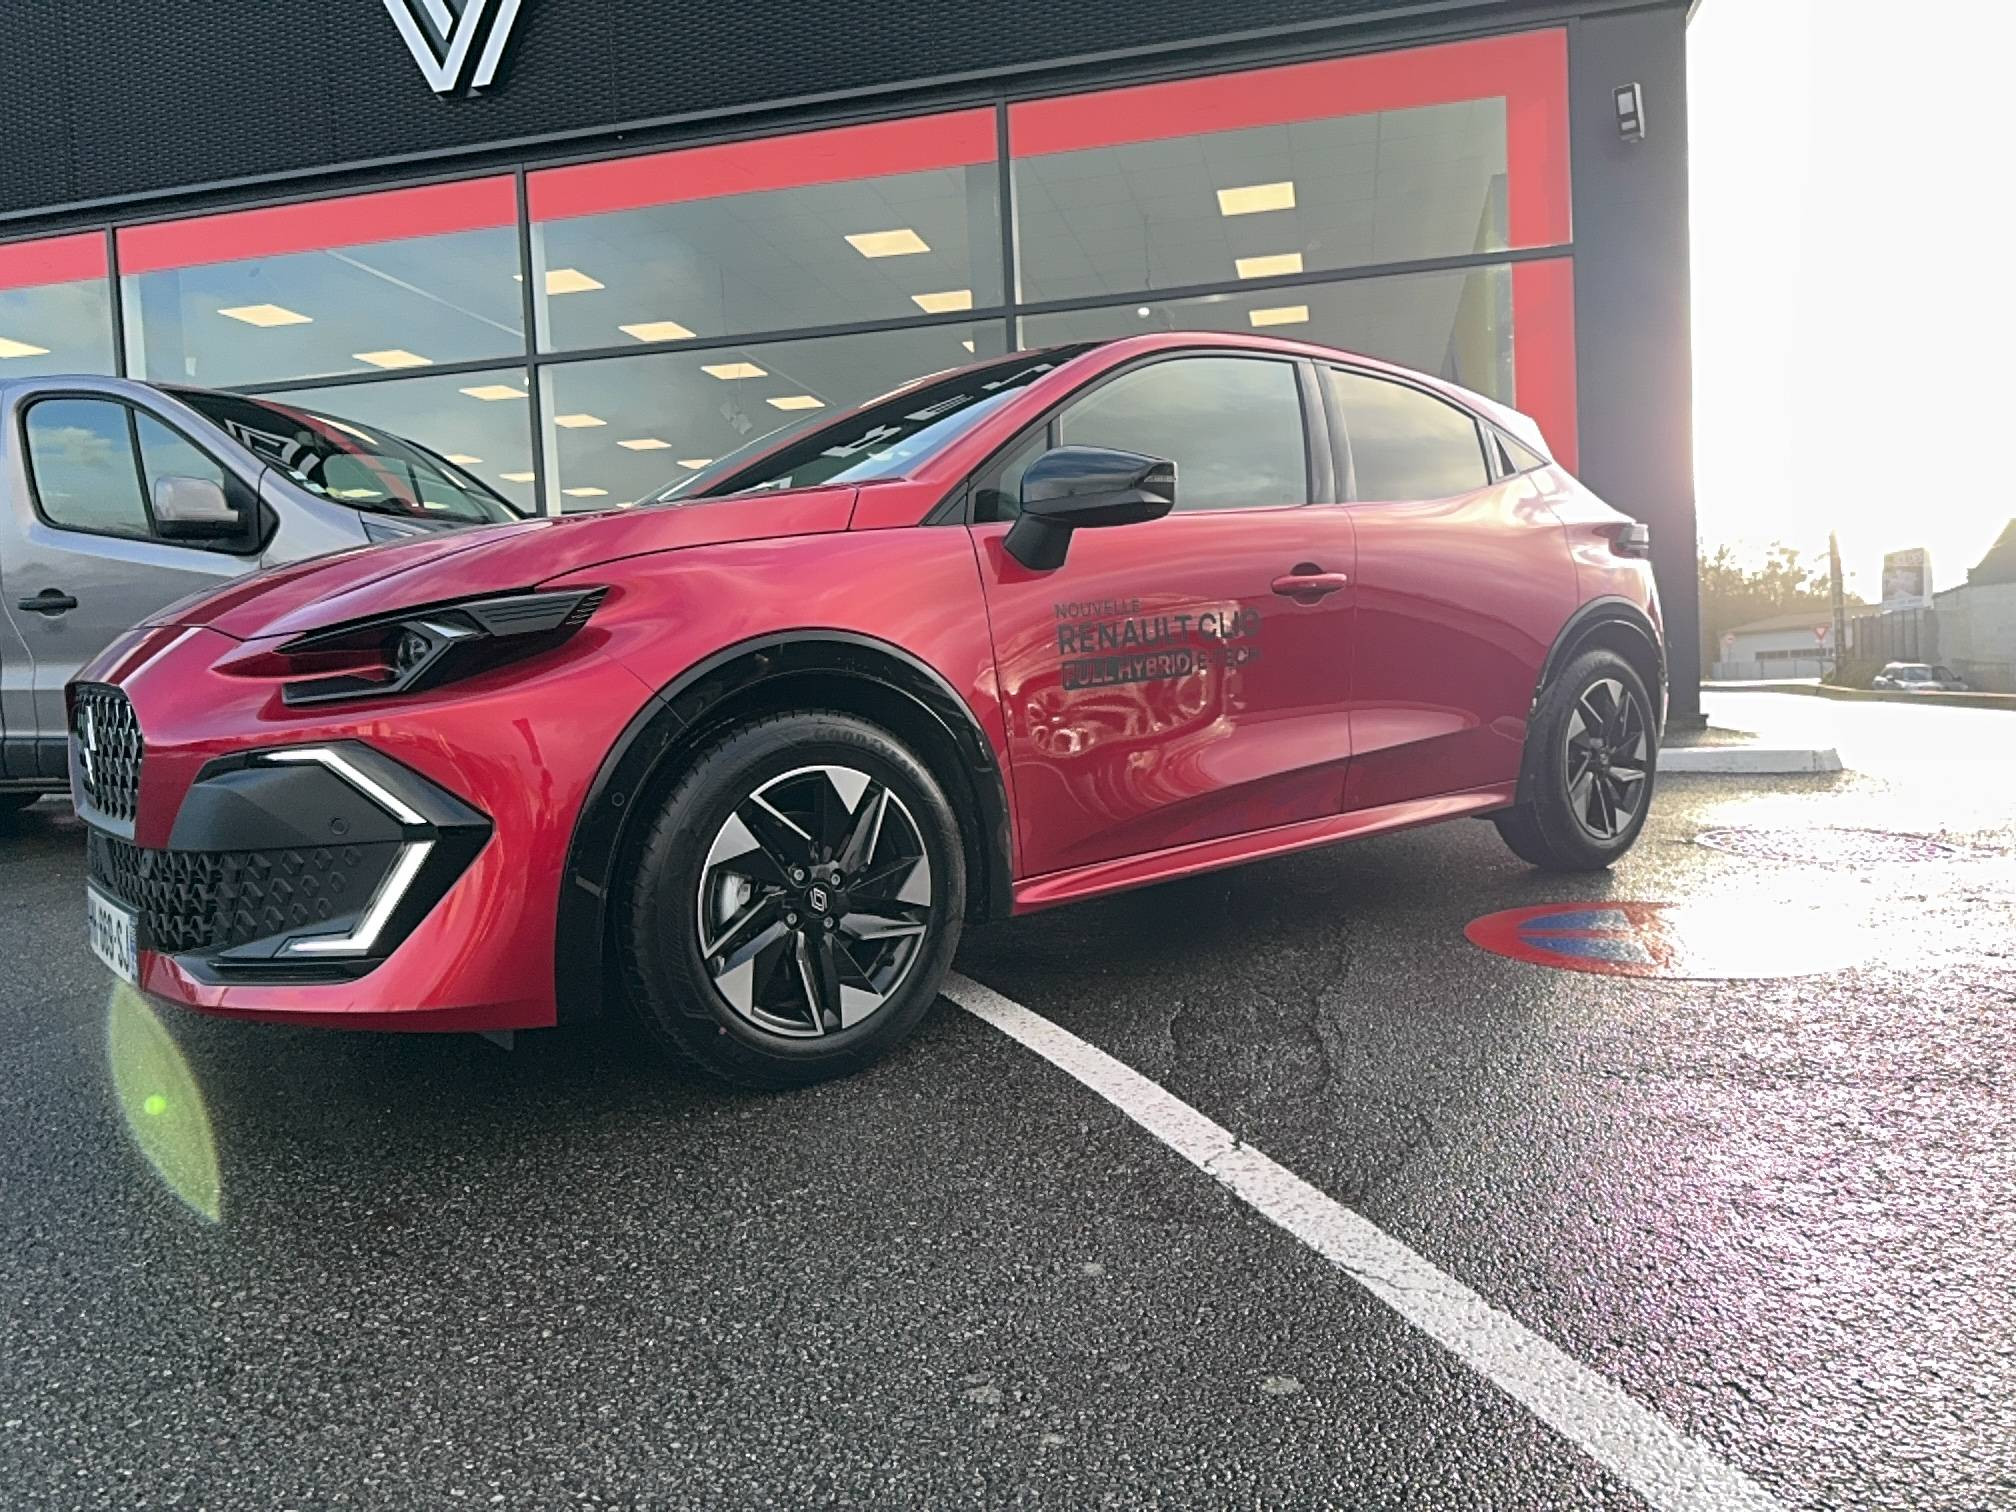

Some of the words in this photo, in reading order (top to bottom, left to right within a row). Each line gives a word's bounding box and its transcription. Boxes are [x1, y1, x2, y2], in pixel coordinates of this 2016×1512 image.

[1055, 599, 1141, 619] NOUVELLE
[1058, 614, 1192, 655] RENAULT
[1198, 607, 1262, 641] CLIO
[1064, 660, 1114, 690] FULL
[1118, 652, 1191, 681] HYBRID
